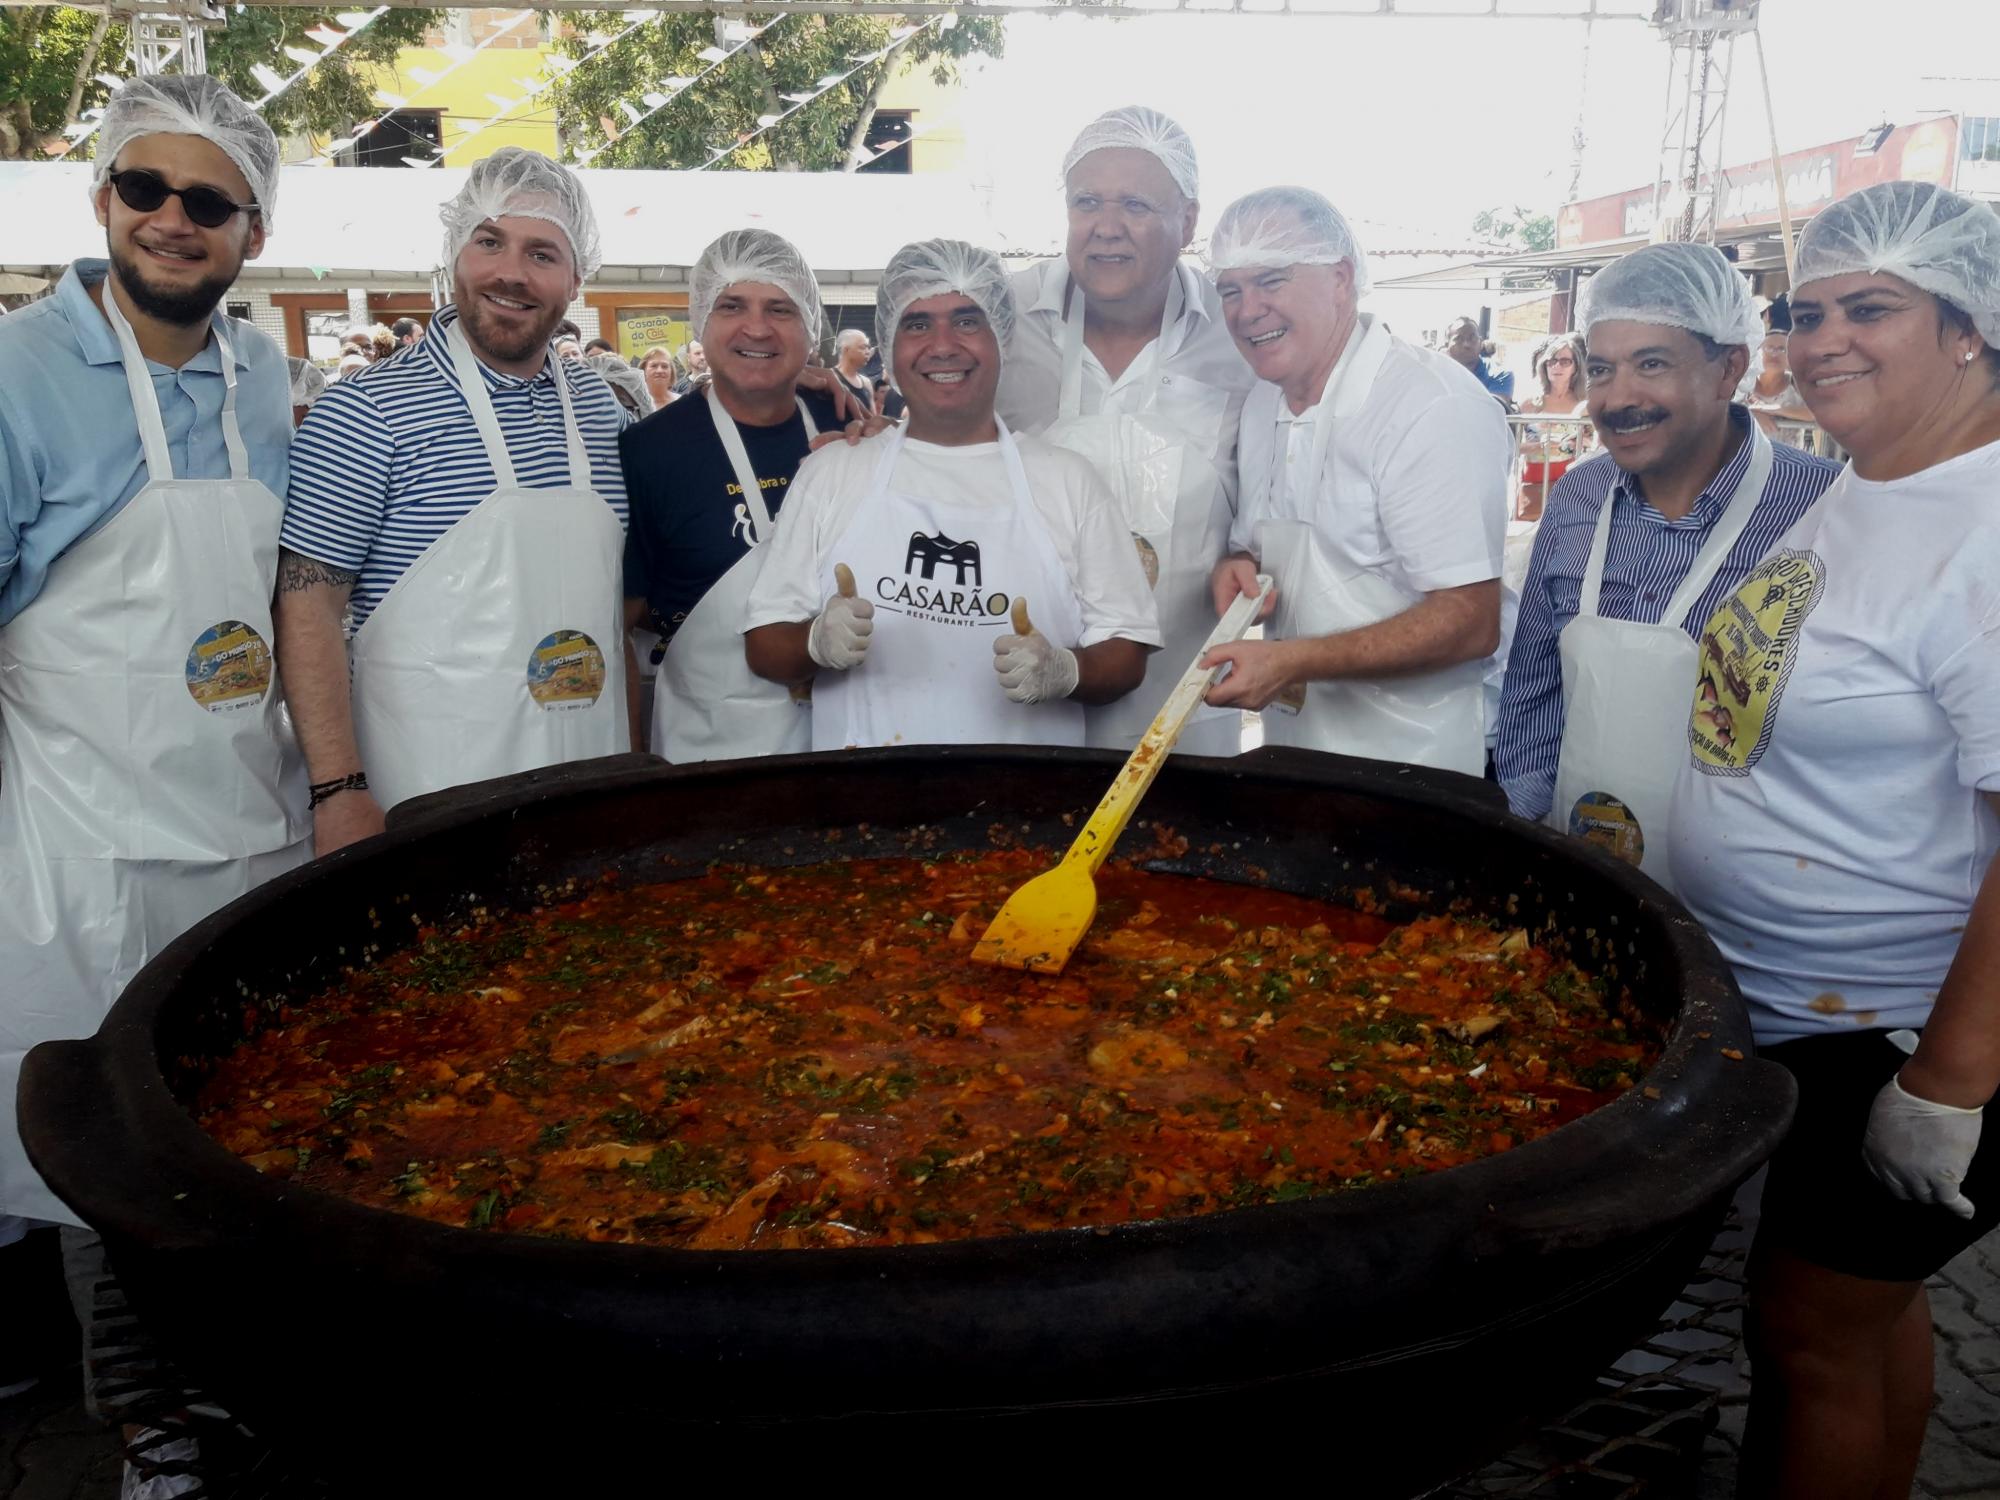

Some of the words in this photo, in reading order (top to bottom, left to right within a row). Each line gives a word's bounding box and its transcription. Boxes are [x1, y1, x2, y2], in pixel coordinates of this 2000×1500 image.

[627, 317, 669, 329] Casarão
[631, 331, 644, 340] do
[726, 477, 778, 496] Debra
[876, 576, 1009, 617] CASARÃO
[906, 610, 975, 627] RESTAURANTE
